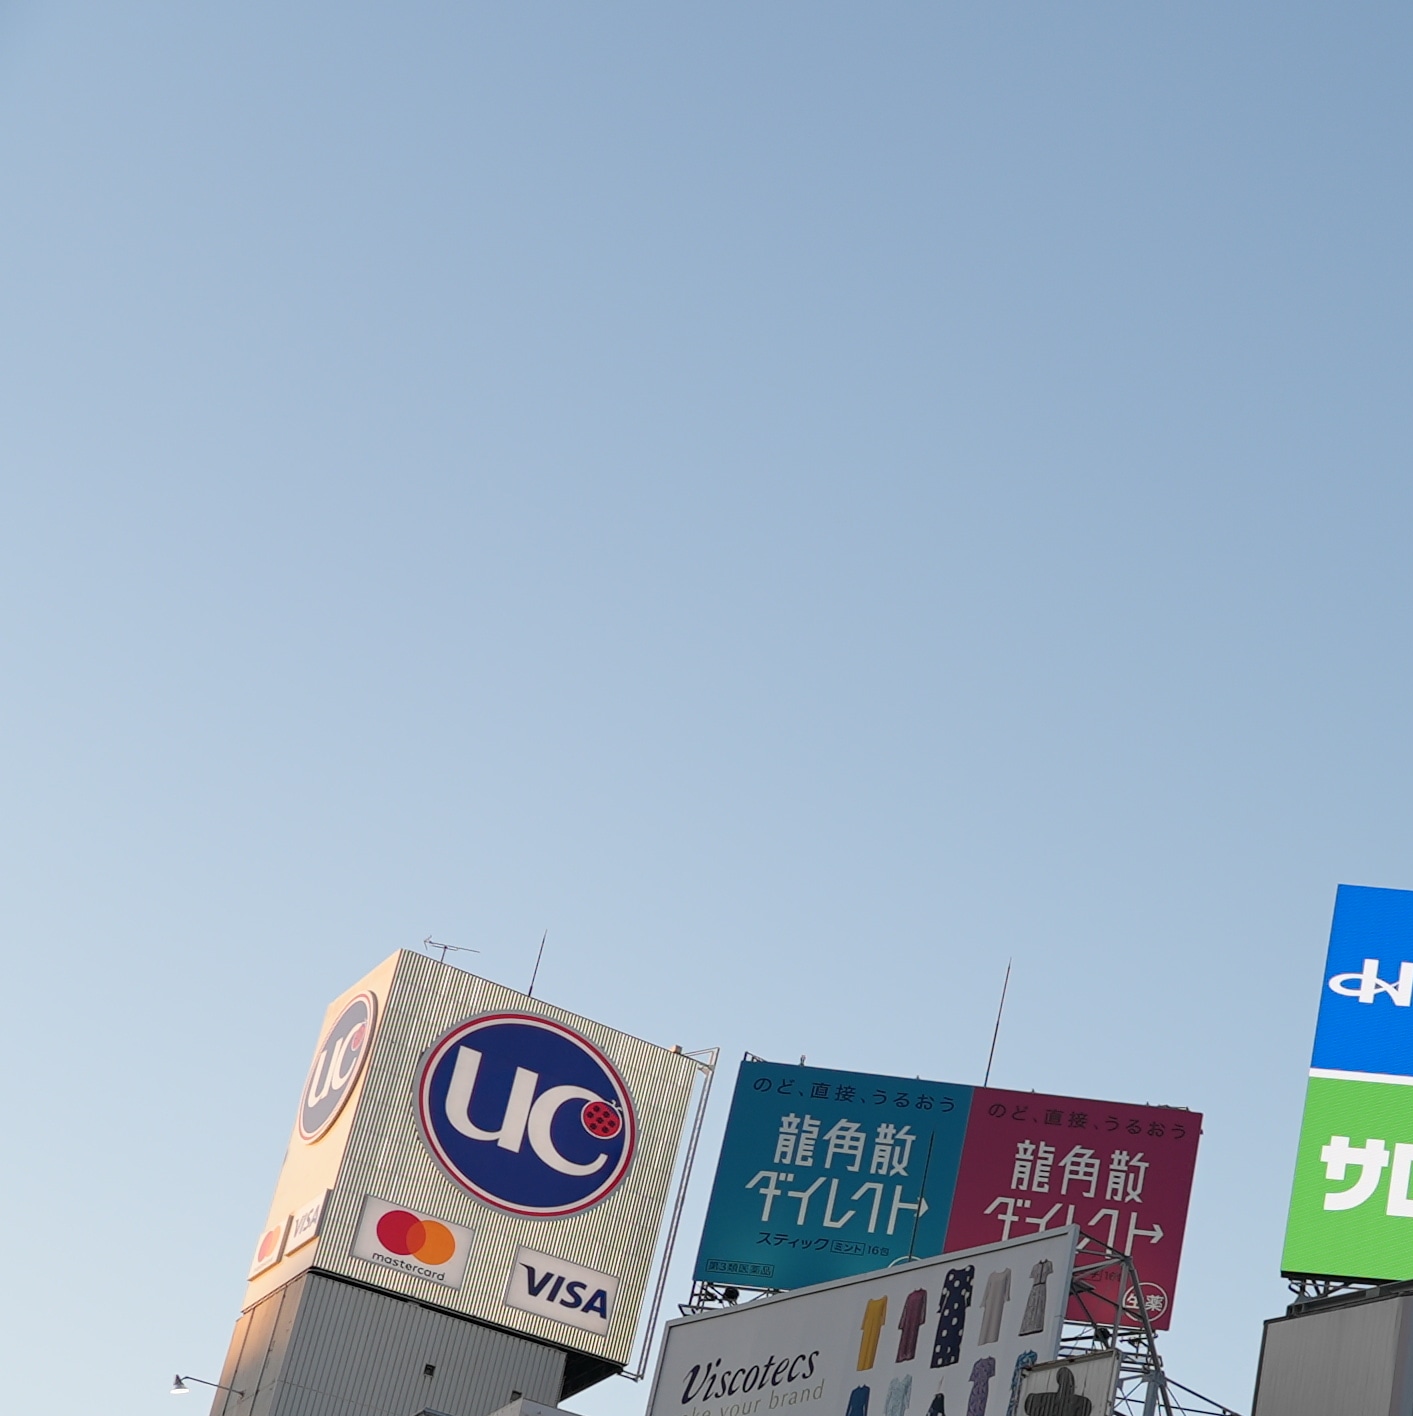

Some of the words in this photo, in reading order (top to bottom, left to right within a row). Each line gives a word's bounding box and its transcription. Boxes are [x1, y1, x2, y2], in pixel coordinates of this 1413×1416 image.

[445, 1045, 610, 1176] UC
[753, 1075, 956, 1114] のど、直接、うるおう
[988, 1102, 1187, 1140] のど、直接、うるおう
[773, 1112, 917, 1177] 龍角散
[1010, 1139, 1150, 1203] 龍角散
[744, 1168, 929, 1235] ダイレクト
[372, 1252, 445, 1281] mastercard
[757, 1230, 830, 1252] スティック
[834, 1242, 863, 1254] ミント
[519, 1262, 608, 1320] VISA
[681, 1350, 820, 1405] Viscotecs
[769, 1378, 825, 1410] brand
